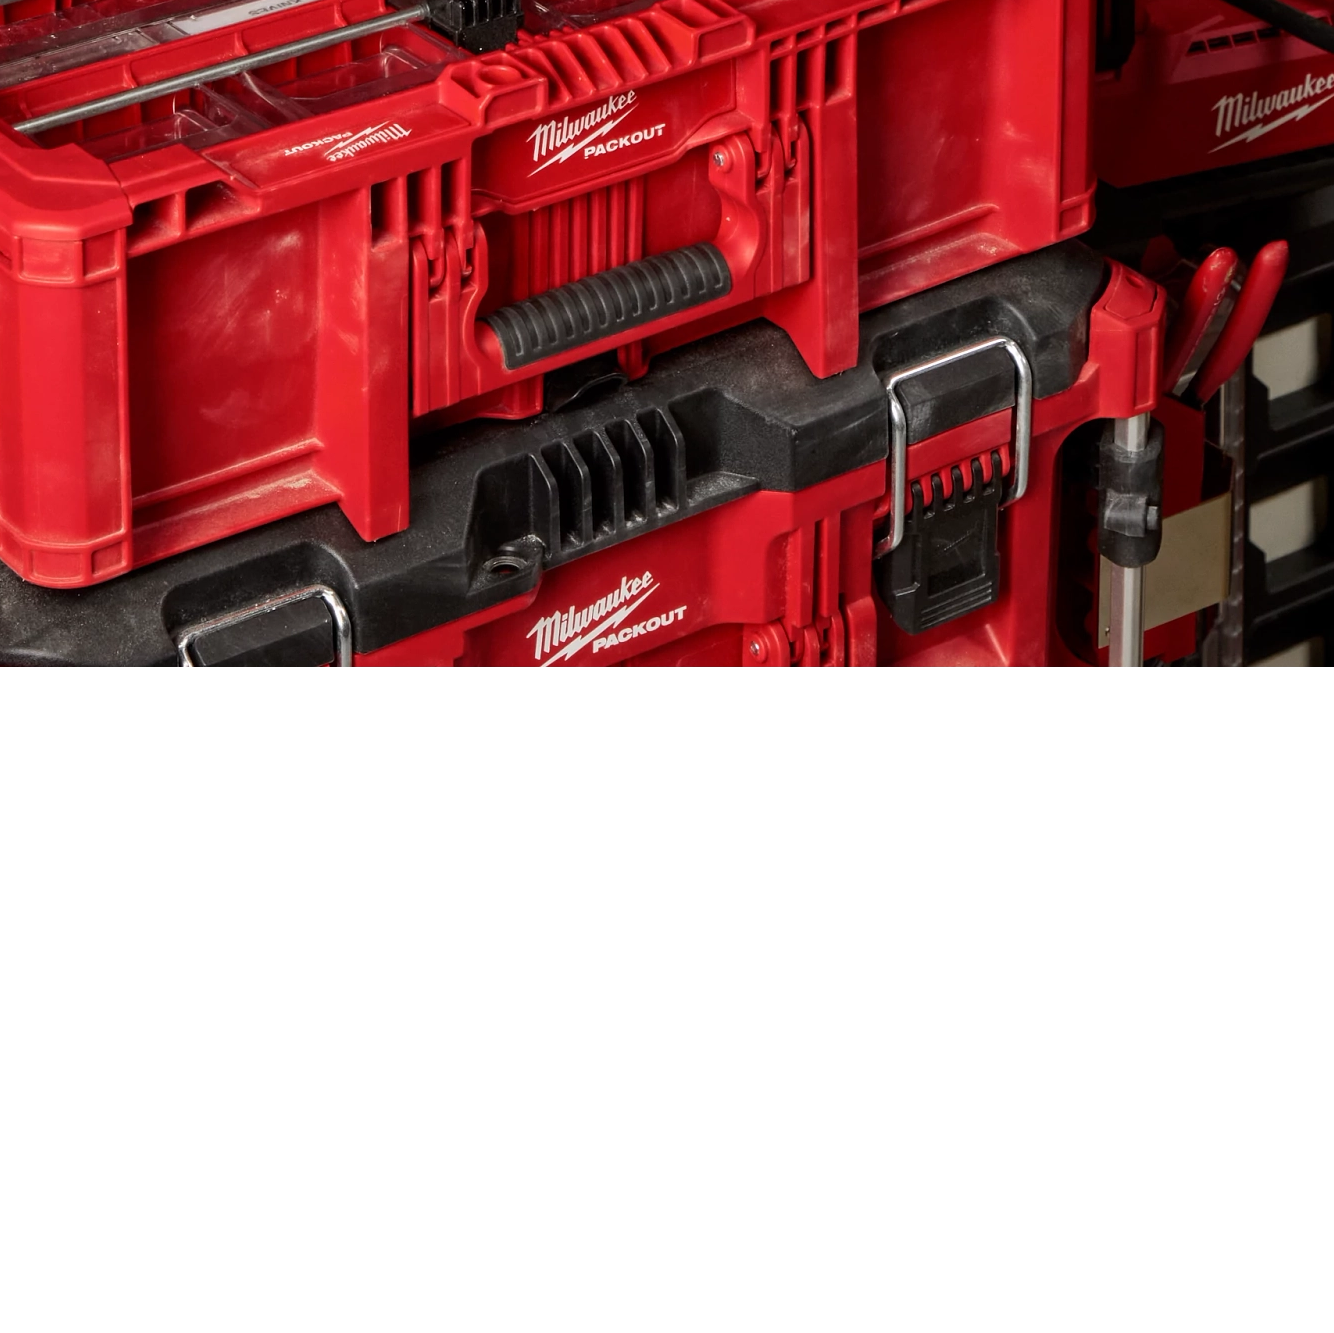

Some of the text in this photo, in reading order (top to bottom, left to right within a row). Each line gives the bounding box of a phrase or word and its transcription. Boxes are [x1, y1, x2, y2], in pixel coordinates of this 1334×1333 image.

[284, 130, 352, 157] PACKOUT
[328, 122, 412, 162] Milwaukee
[526, 90, 638, 161] Milwaukee
[584, 123, 666, 158] PACKOUT
[526, 570, 654, 659] Milwaukee
[593, 606, 688, 653] PACKOUT
